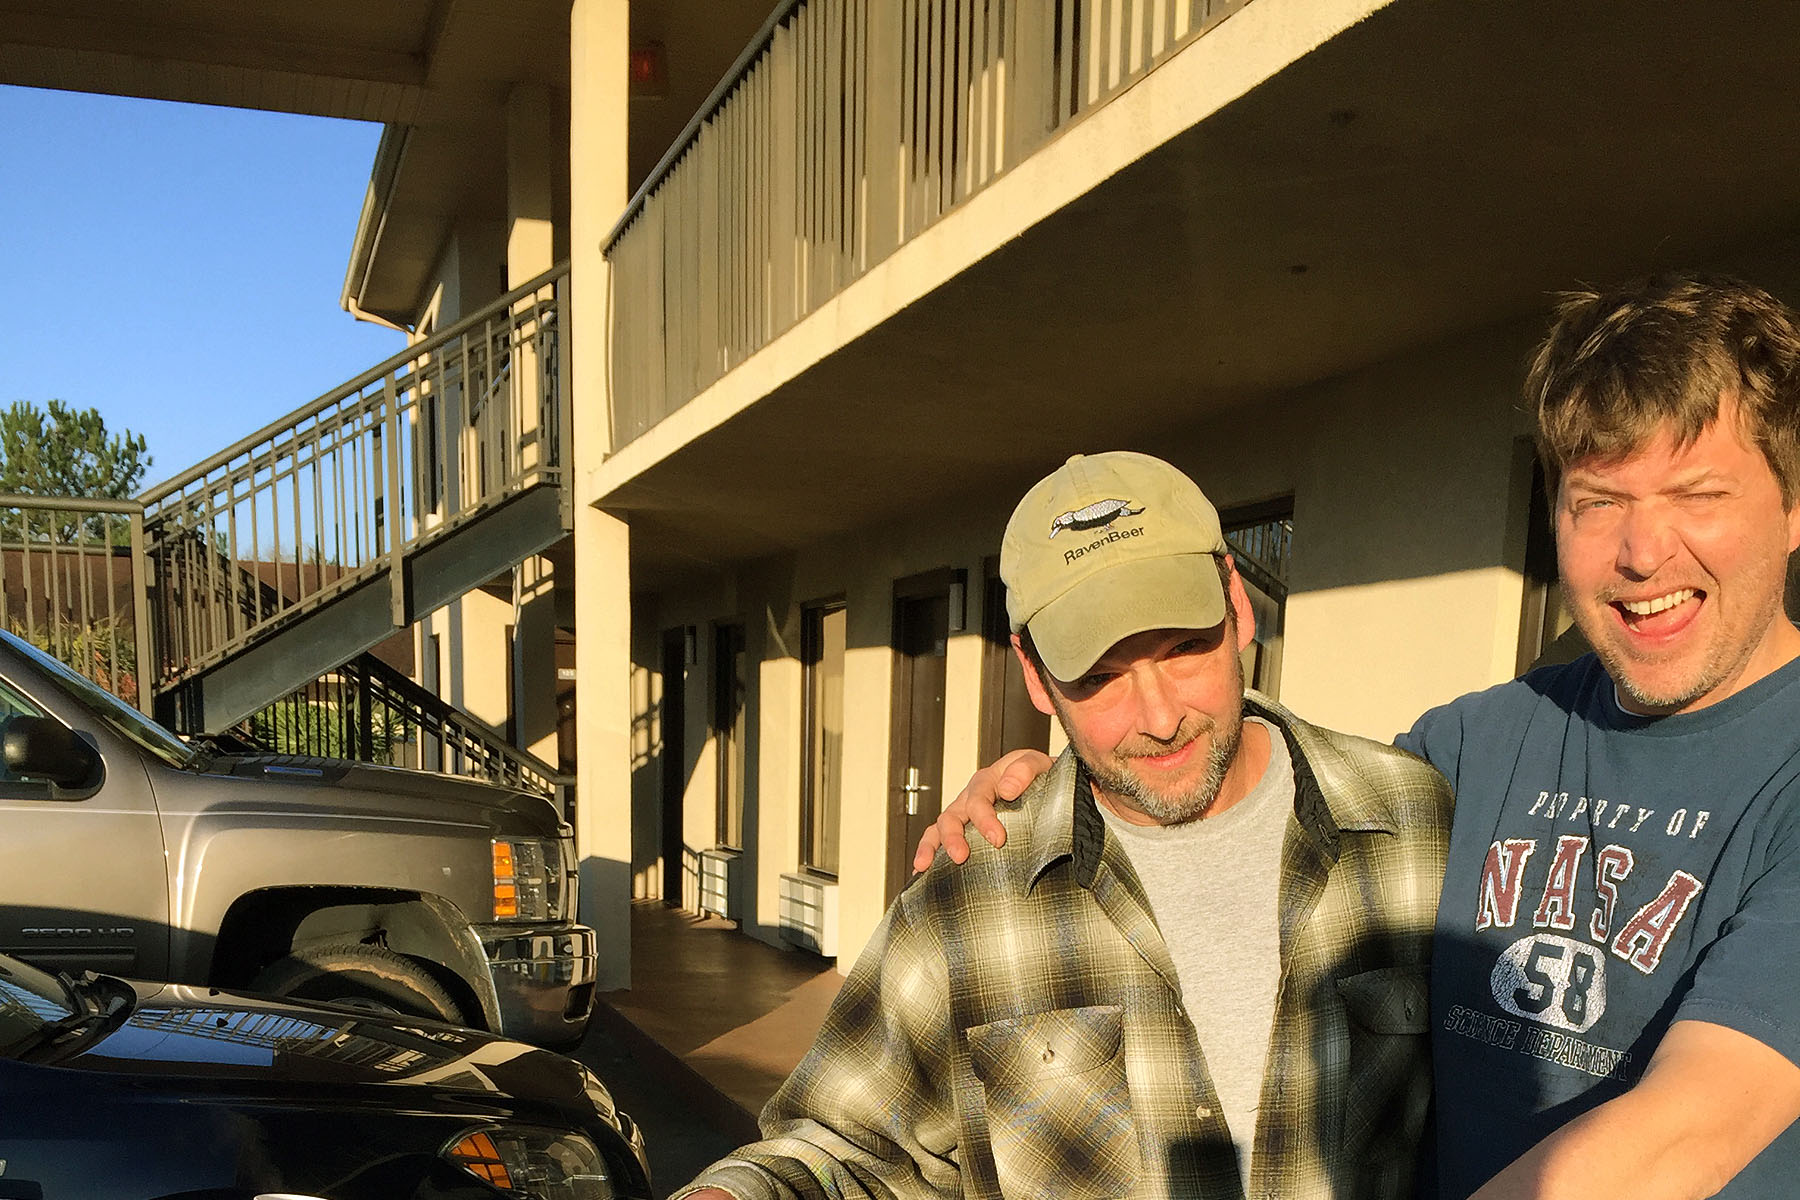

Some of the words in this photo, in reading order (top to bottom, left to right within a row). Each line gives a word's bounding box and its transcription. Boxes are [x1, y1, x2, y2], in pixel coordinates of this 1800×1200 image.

[1063, 526, 1145, 565] RavenBeer
[1527, 791, 1655, 833] POPRTY
[1665, 808, 1711, 839] OF
[1475, 834, 1703, 975] NASA
[1513, 941, 1596, 1026] 58
[1519, 1026, 1632, 1082] DEPARMENT
